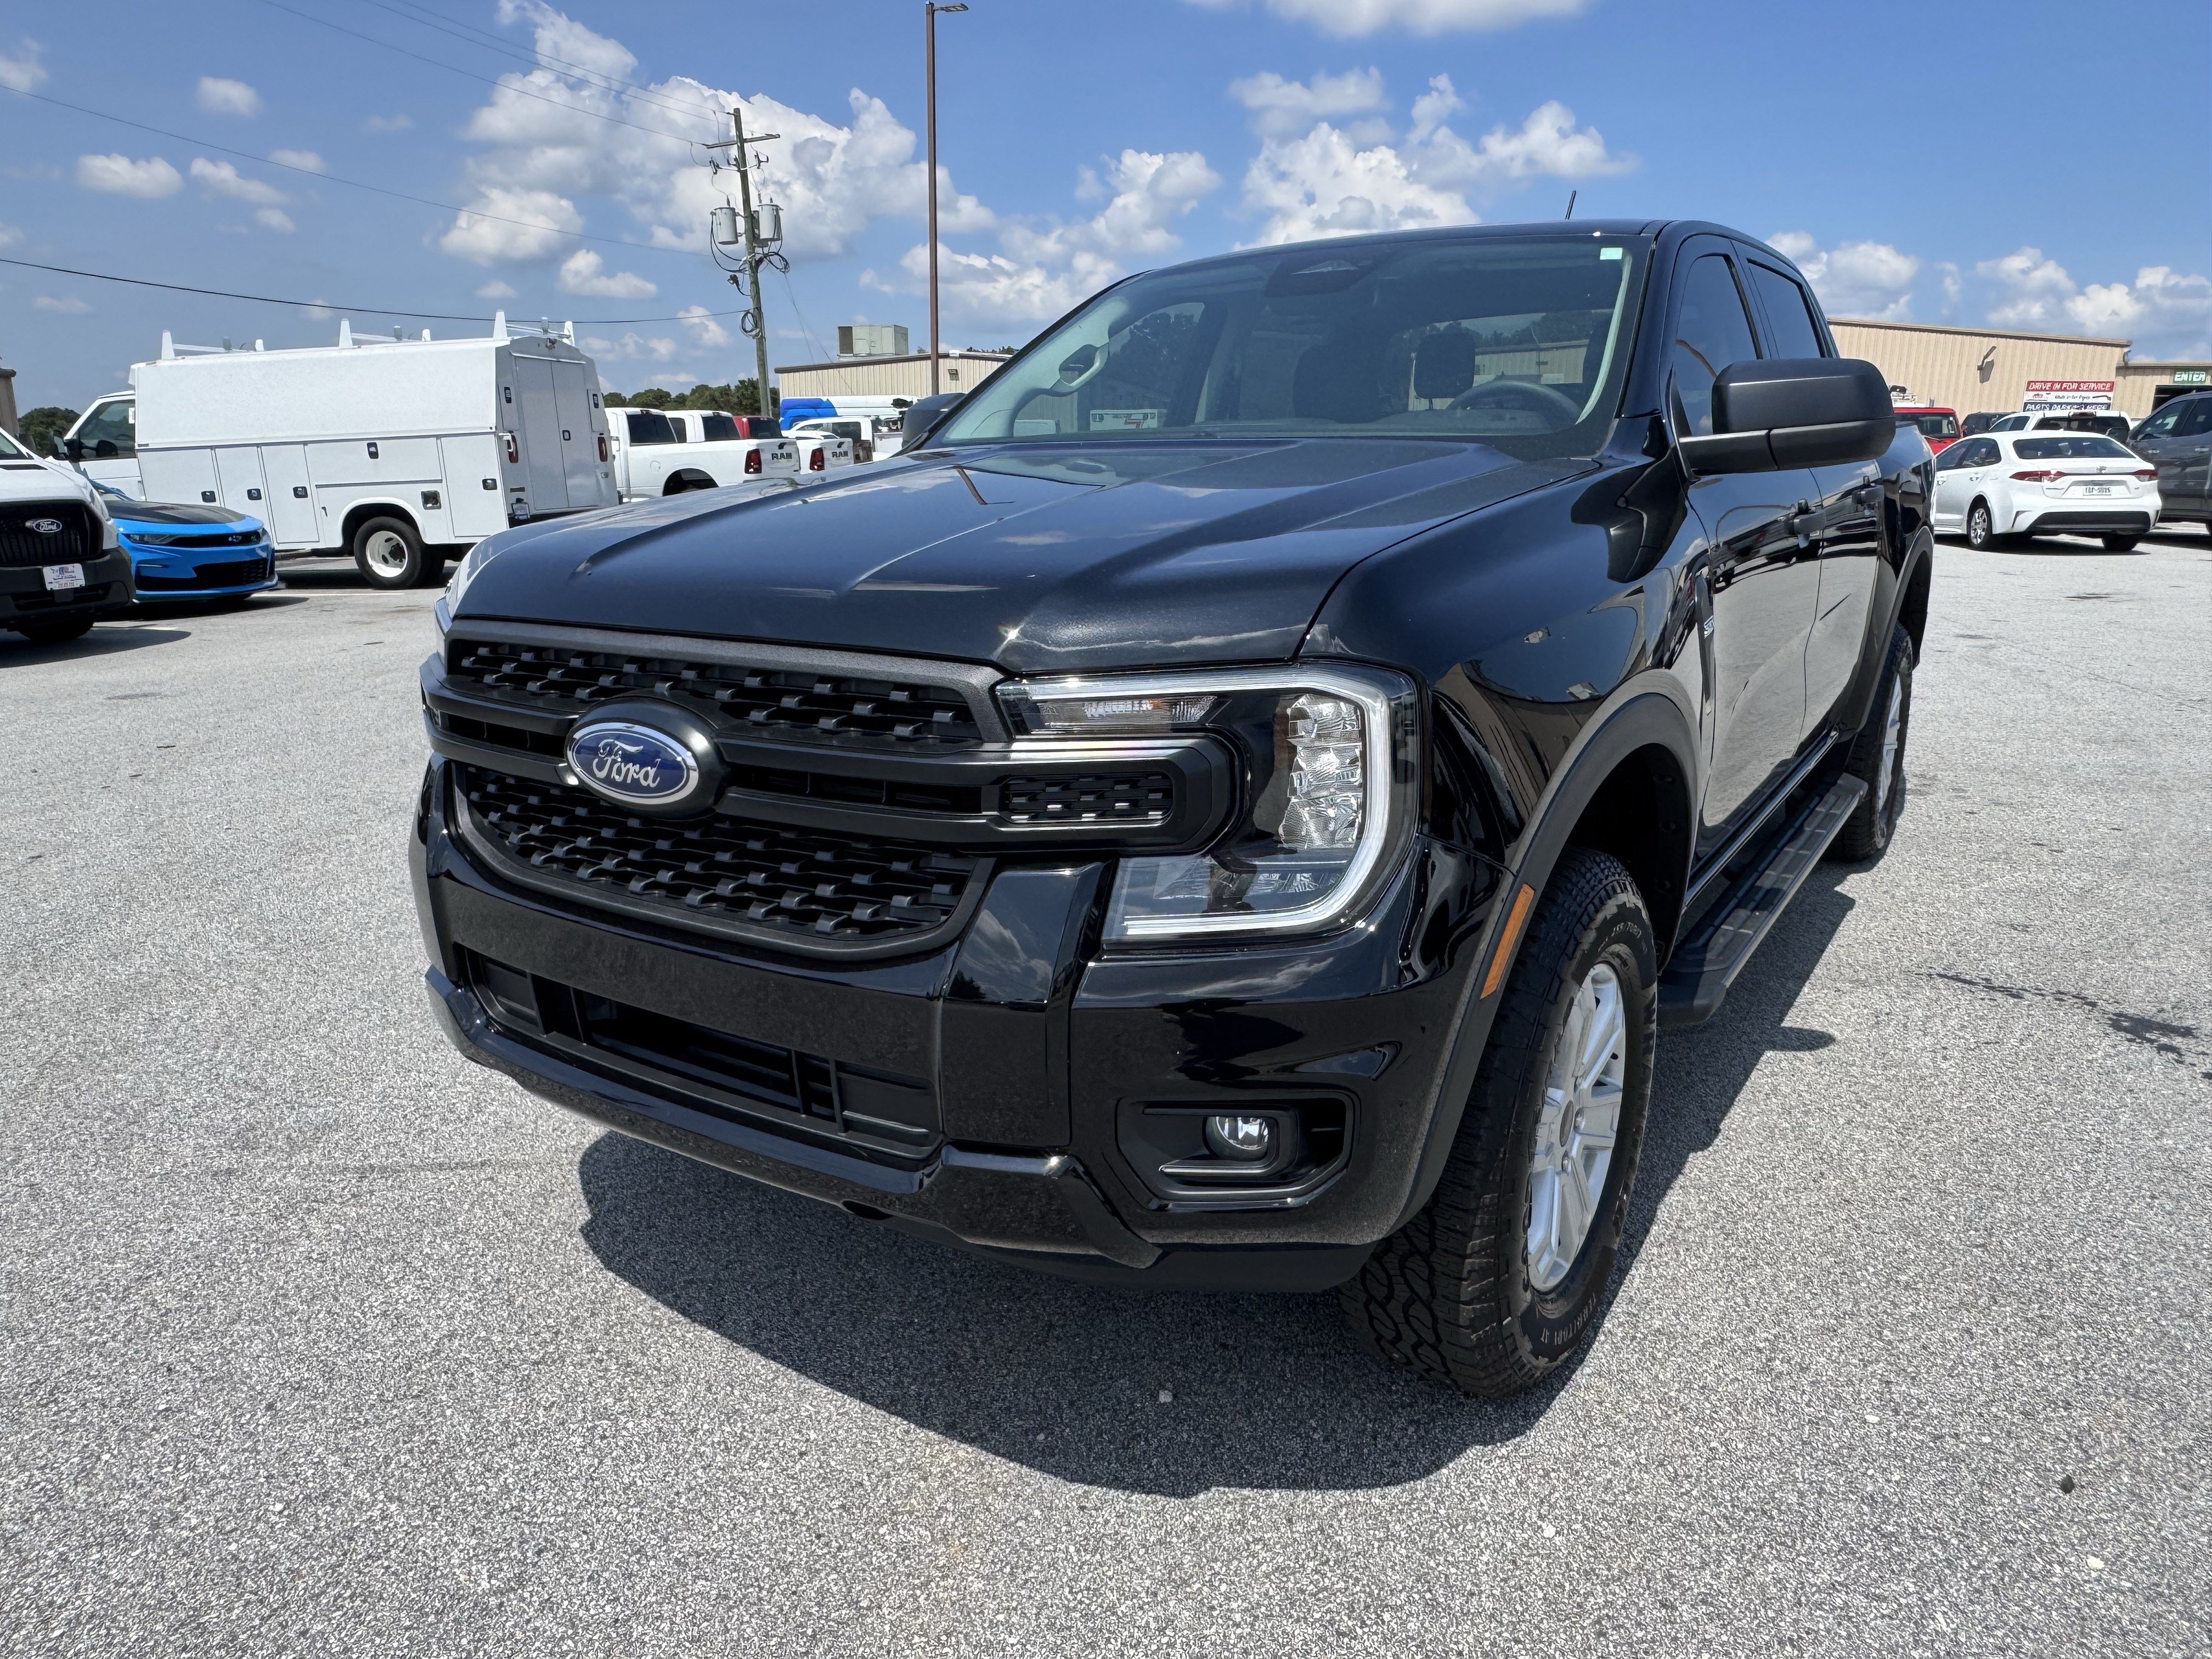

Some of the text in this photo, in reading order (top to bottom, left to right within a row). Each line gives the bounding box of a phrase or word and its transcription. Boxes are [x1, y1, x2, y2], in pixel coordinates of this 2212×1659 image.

[2174, 371, 2205, 382] ENTER
[771, 452, 792, 460] RAM
[40, 521, 57, 531] Ford
[592, 738, 661, 788] Ford
